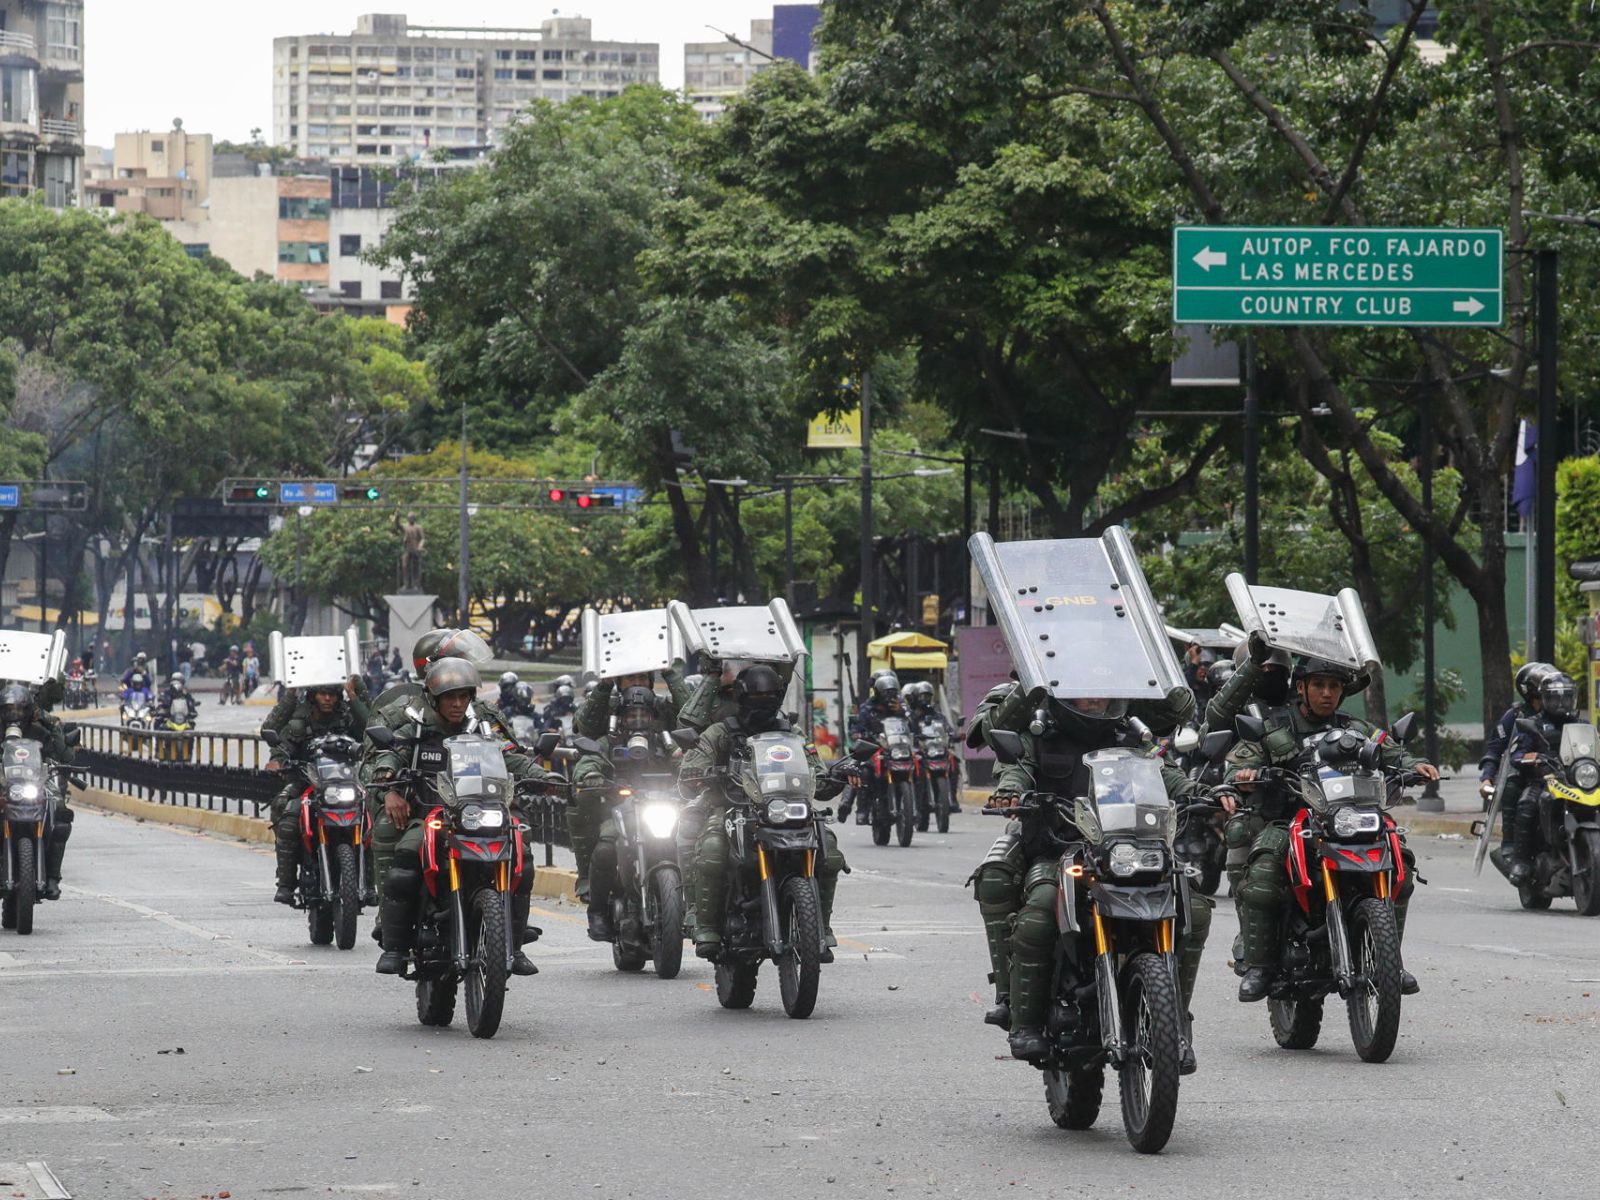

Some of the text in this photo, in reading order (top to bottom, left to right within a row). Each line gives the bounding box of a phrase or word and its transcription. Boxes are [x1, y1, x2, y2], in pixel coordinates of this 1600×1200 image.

[1241, 237, 1487, 257] AUTOP. FCO. FAJARDO
[1240, 262, 1415, 281] LAS MERCEDES
[1240, 296, 1412, 315] COUNTRY CLUB
[824, 423, 852, 435] EPA
[1044, 595, 1098, 607] GNB
[421, 752, 442, 762] GNB
